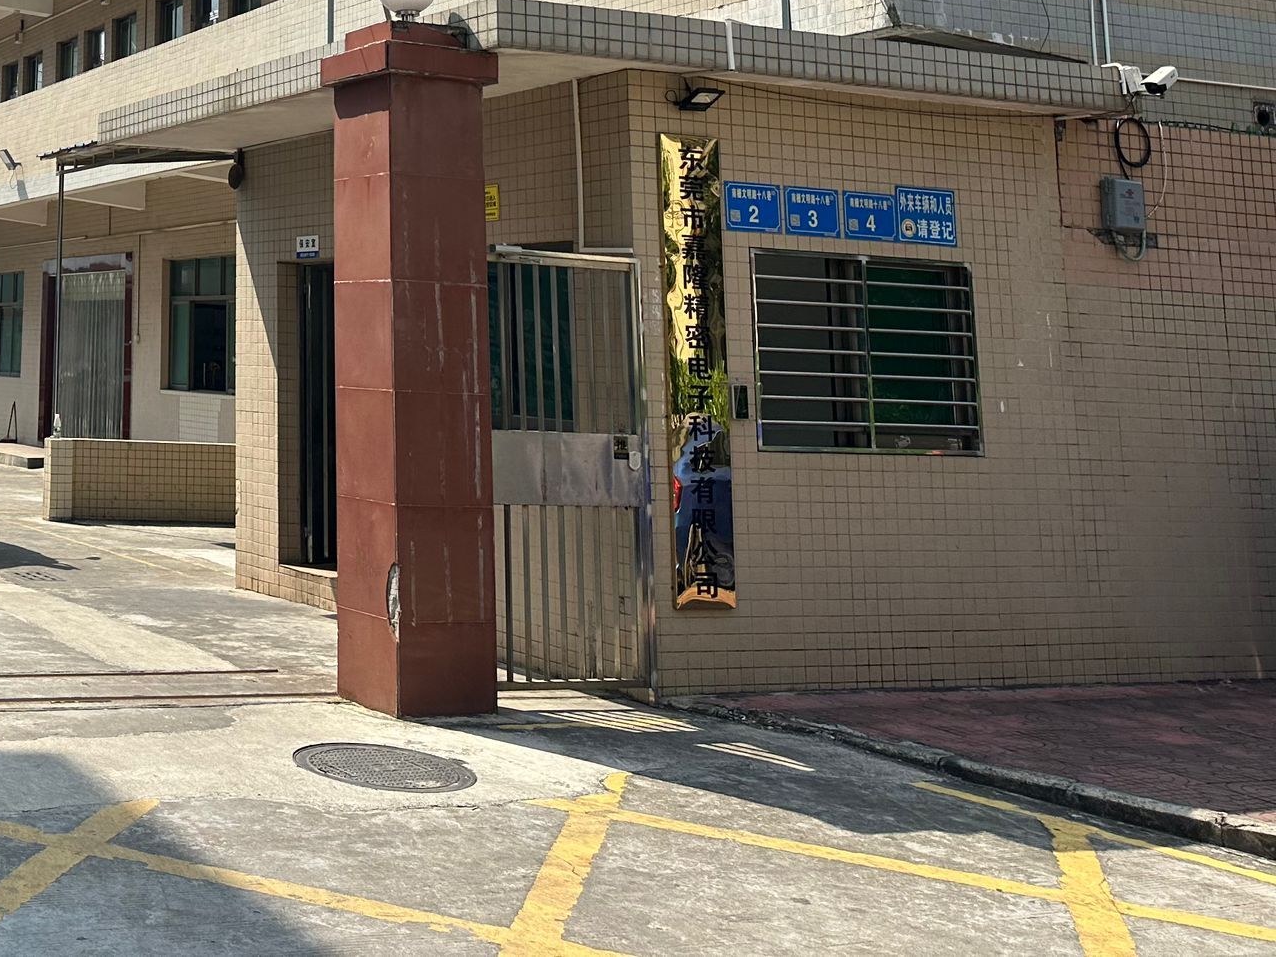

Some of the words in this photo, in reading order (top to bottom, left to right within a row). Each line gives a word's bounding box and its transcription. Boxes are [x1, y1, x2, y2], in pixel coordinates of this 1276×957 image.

[899, 192, 952, 215] 外来车辆和人员
[748, 205, 759, 223] 2
[808, 210, 818, 227] 3
[866, 214, 876, 232] 4
[917, 218, 953, 240] 请登记
[678, 147, 718, 599] 东莞市嘉隆精密电子科技有限公司
